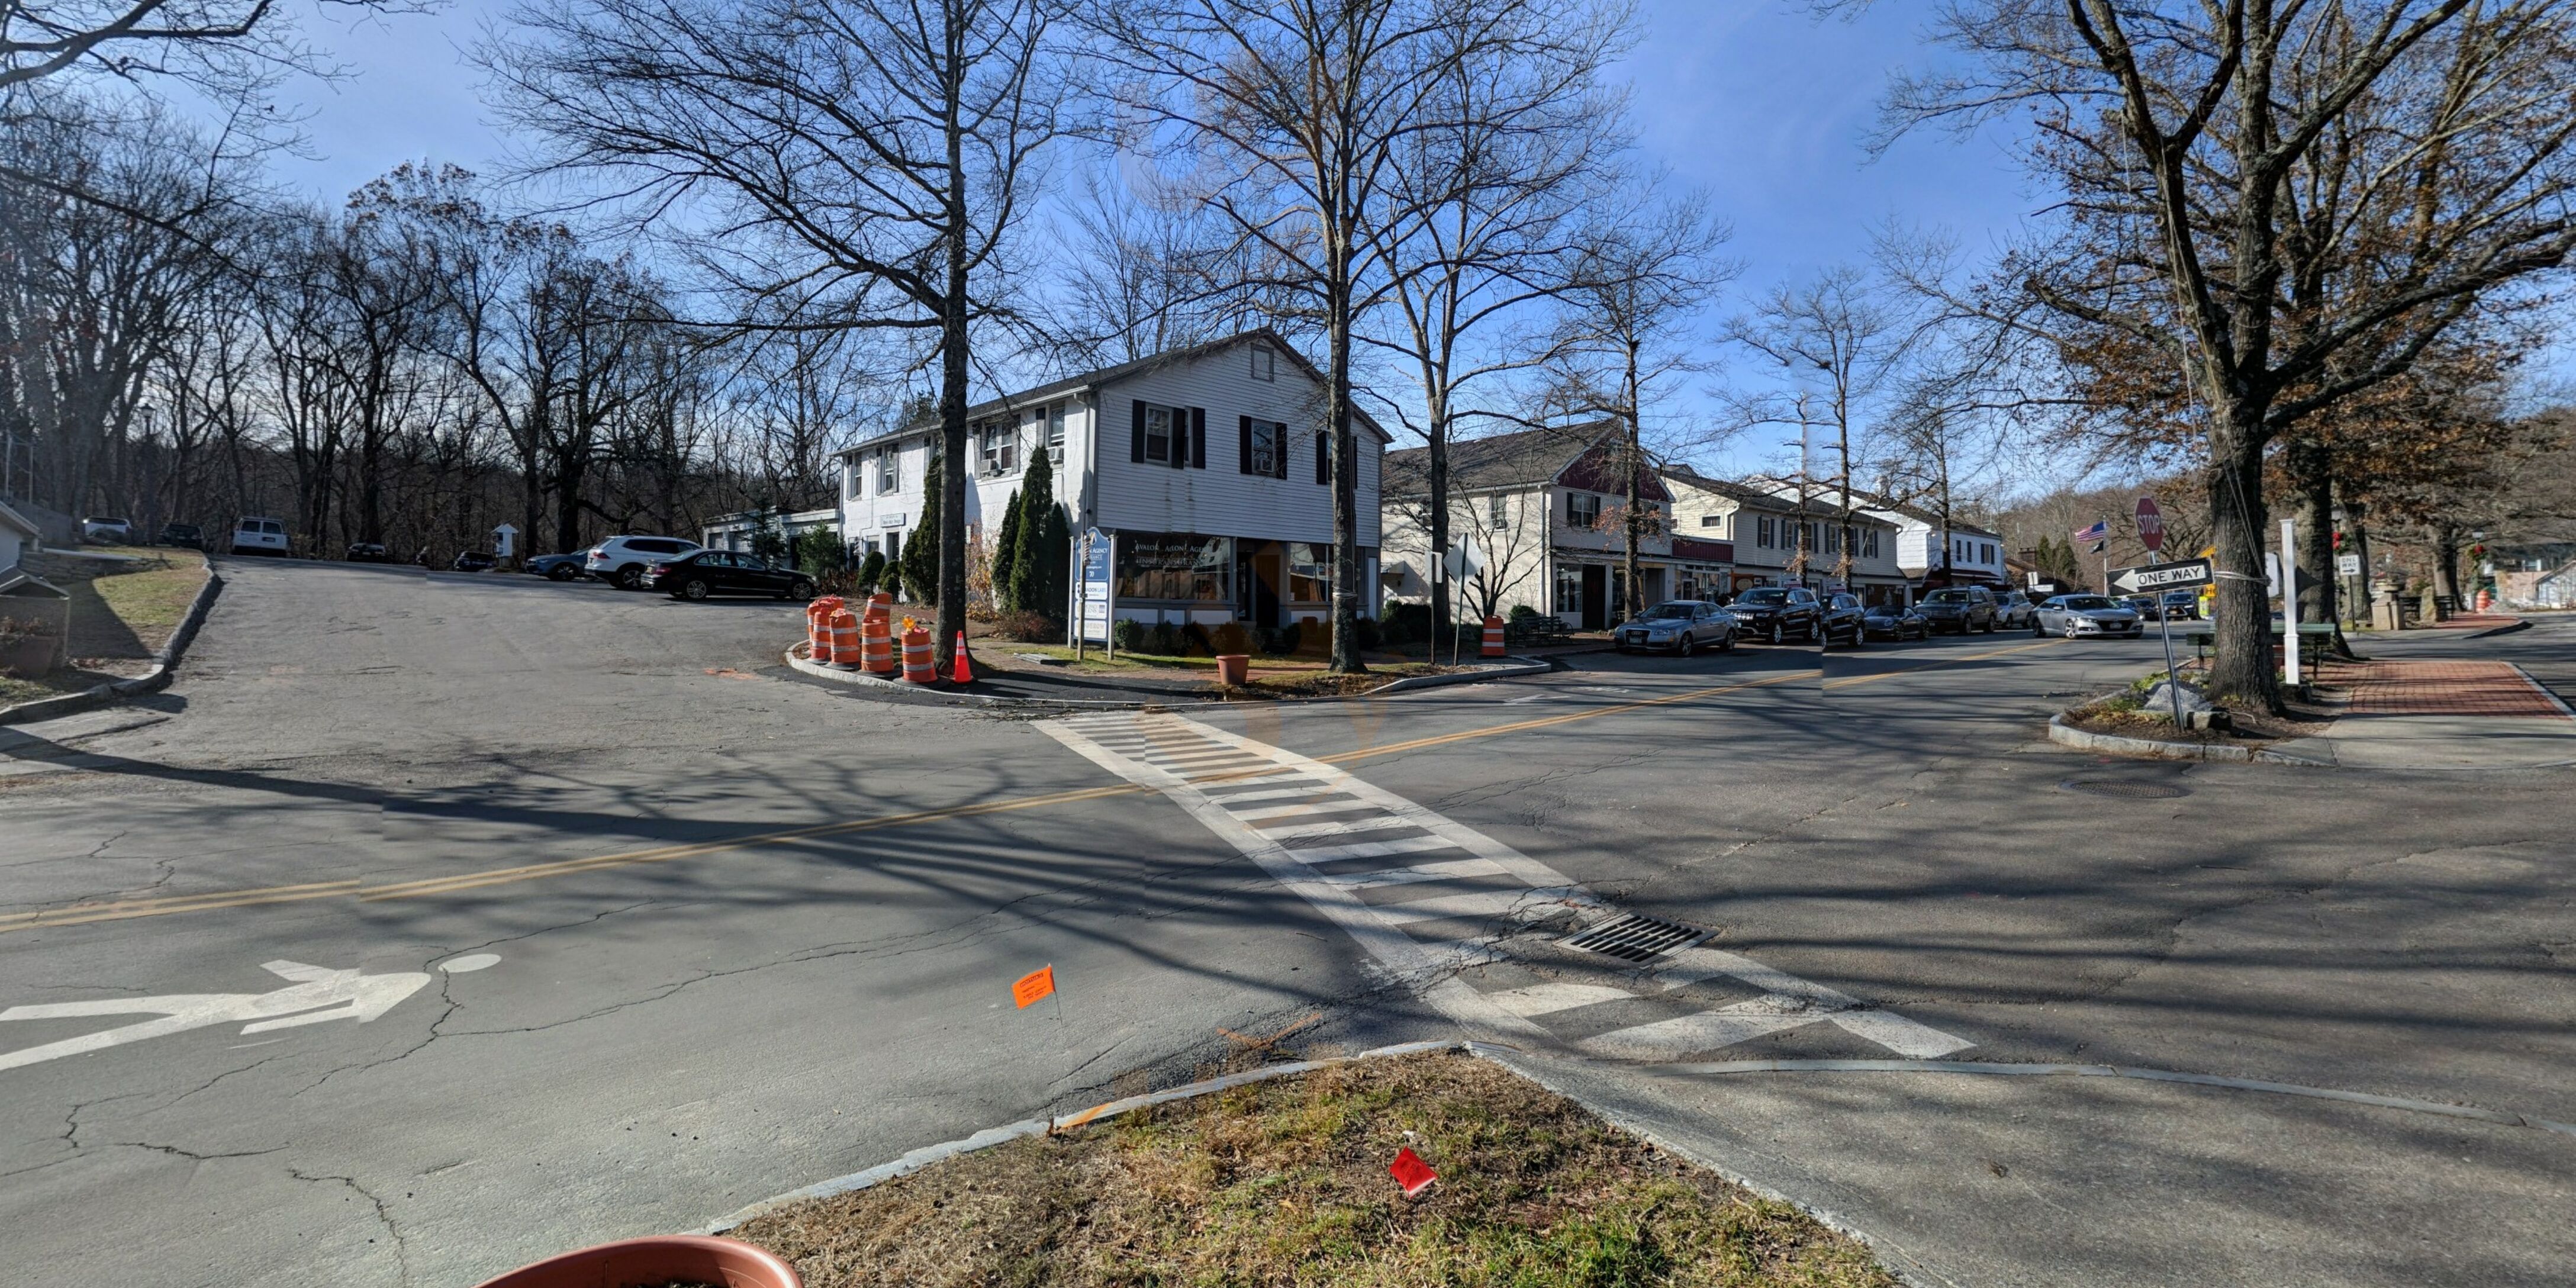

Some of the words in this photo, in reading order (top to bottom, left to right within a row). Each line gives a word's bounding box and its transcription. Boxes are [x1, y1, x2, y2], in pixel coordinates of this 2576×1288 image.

[2137, 515, 2160, 534] STOP
[2138, 572, 2168, 585] ONE
[2171, 567, 2201, 580] WAY
